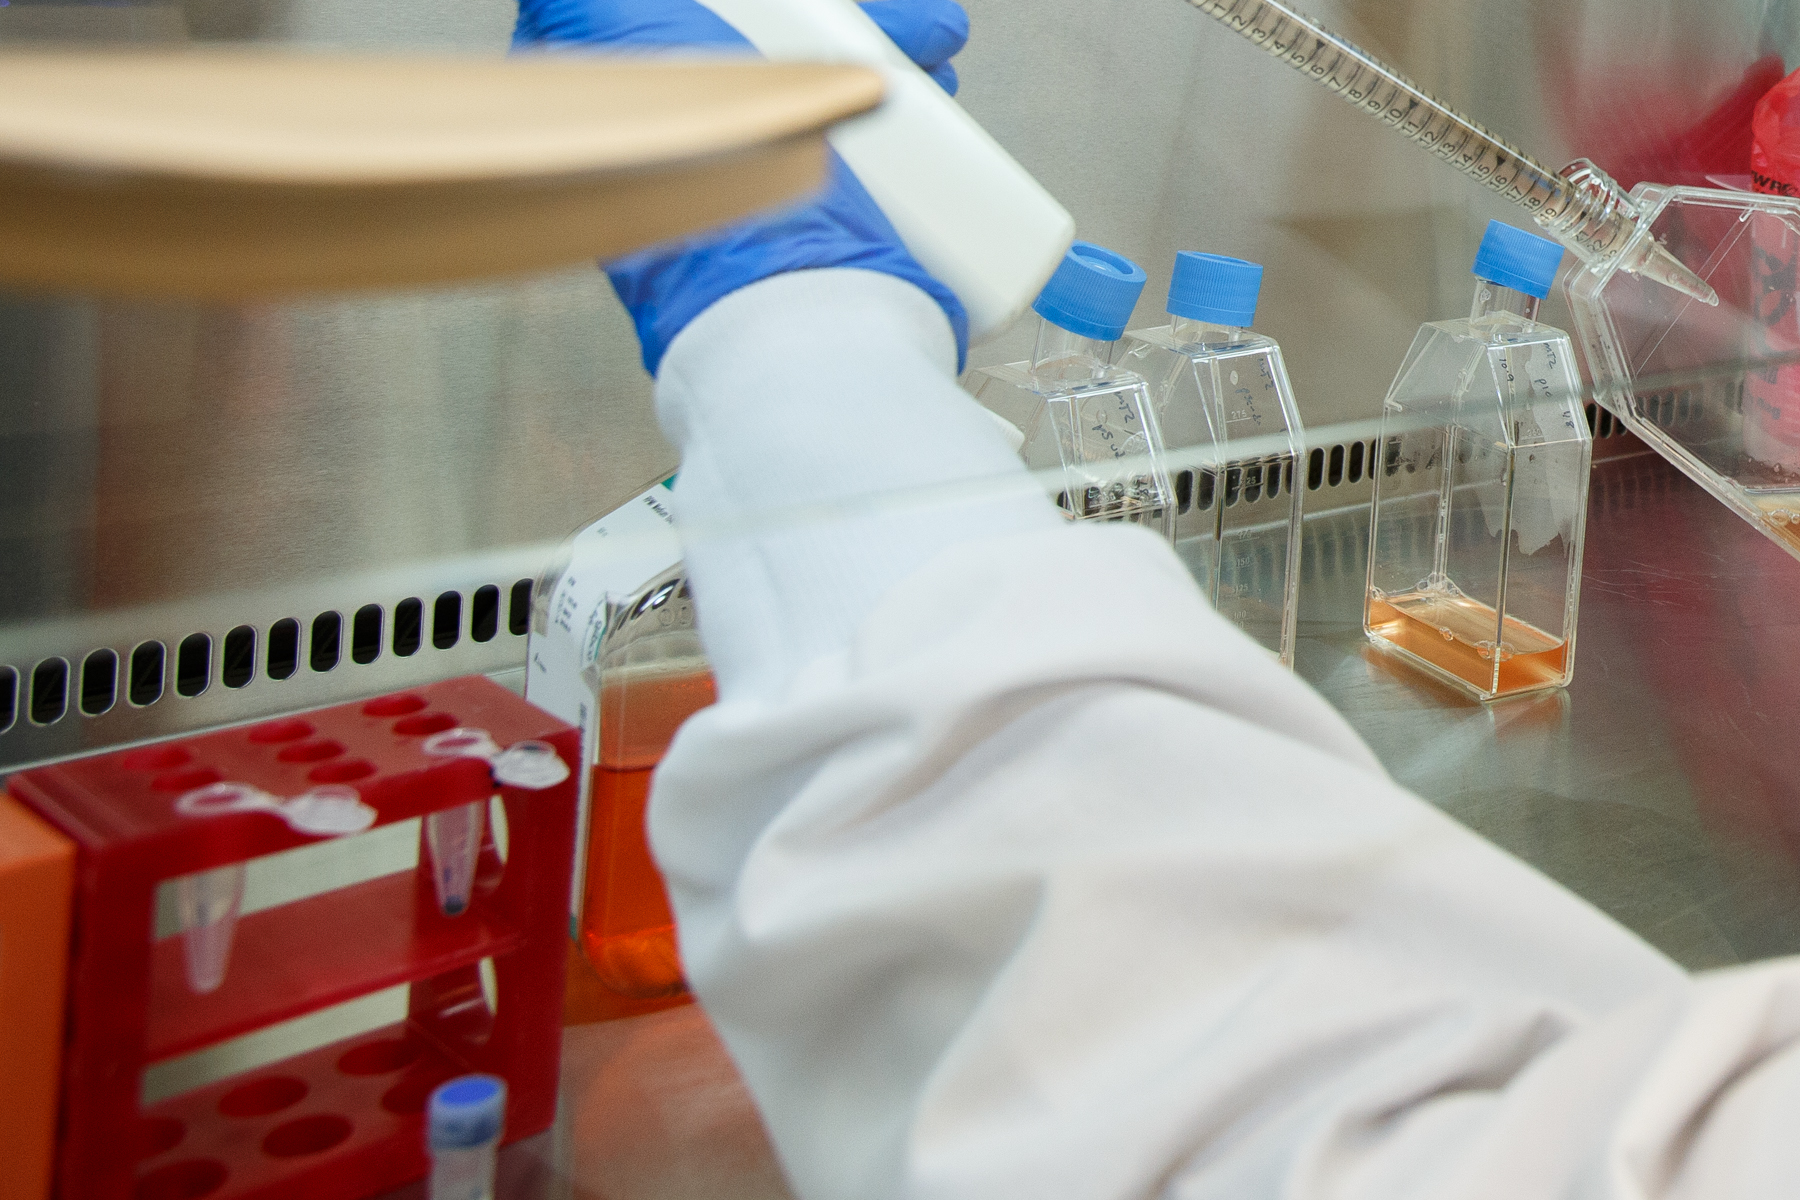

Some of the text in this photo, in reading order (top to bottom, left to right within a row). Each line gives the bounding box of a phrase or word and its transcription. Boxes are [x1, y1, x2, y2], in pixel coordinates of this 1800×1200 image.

[1232, 15, 1247, 26] 2
[1252, 27, 1266, 38] 3
[1273, 40, 1286, 50] 4
[1291, 52, 1305, 63] 5
[1311, 64, 1324, 75] 6
[1329, 76, 1342, 88] 7
[1348, 88, 1362, 99] 8
[1367, 100, 1381, 111] 9
[1384, 108, 1403, 123] 10
[1402, 120, 1419, 133] 11
[1419, 131, 1438, 145] 12
[1438, 142, 1456, 156] 13
[1455, 153, 1473, 168] 14
[1472, 164, 1490, 178] 15
[1490, 175, 1507, 189] 16
[1506, 186, 1523, 200] 17
[1523, 197, 1541, 211] 18
[1540, 207, 1557, 221] 19
